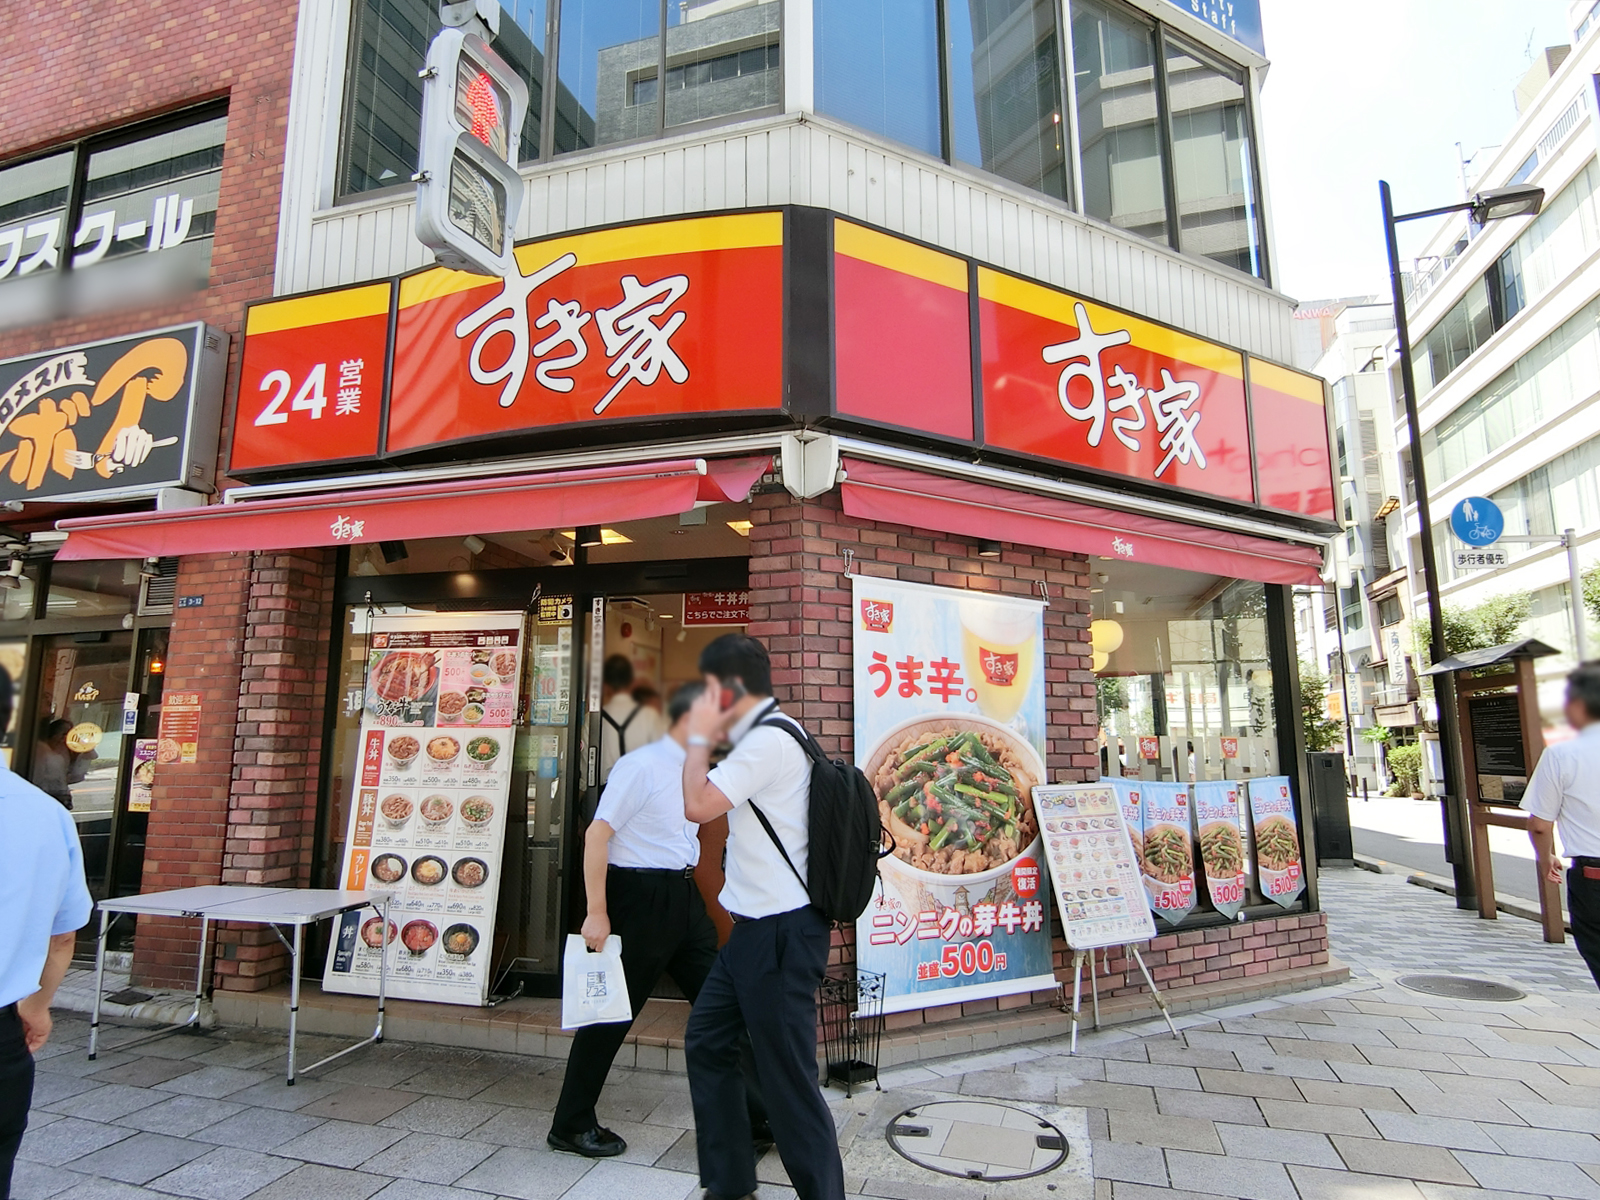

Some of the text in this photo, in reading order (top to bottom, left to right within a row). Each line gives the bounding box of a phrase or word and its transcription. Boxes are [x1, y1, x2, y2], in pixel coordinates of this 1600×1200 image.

[1191, 0, 1236, 35] Staff
[455, 252, 690, 415] すき家
[254, 358, 364, 427] 24 営業
[1042, 302, 1207, 479] すき家
[330, 515, 365, 541] すき家
[1112, 536, 1134, 557] すき家
[1457, 553, 1505, 565] 歩行者優先
[865, 601, 890, 624] すき家
[867, 651, 978, 703] うま辛。
[984, 652, 1015, 677] すき家
[368, 738, 380, 760] 牛丼
[353, 853, 365, 887] カレー
[1017, 877, 1036, 891] 復活
[870, 901, 1043, 945] ニンニクの芽牛丼
